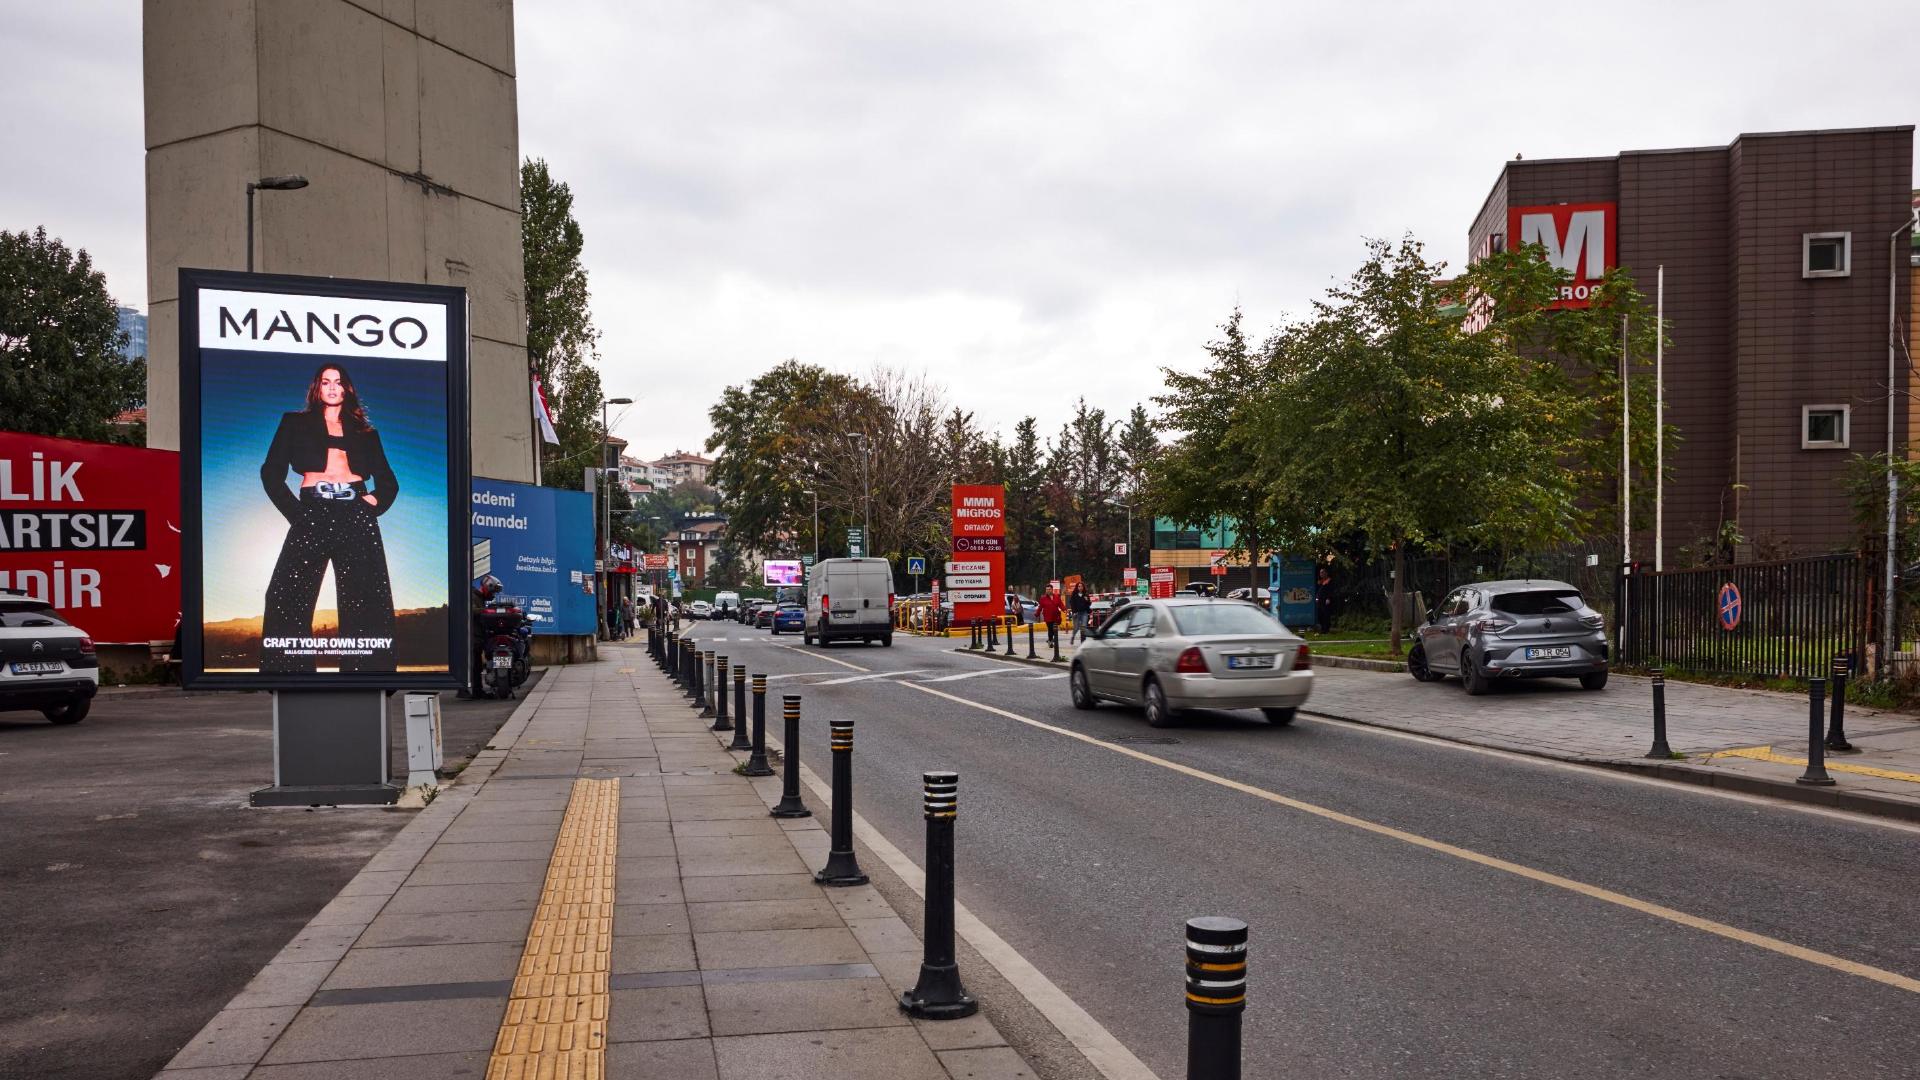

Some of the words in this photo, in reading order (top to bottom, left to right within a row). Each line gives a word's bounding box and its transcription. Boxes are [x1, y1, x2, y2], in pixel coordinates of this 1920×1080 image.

[1521, 210, 1604, 280] M
[220, 306, 428, 349] MANGO
[0, 452, 84, 502] LİK
[964, 498, 994, 507] MMM
[263, 637, 298, 648] CRAFT
[299, 638, 328, 648] YOUR
[330, 638, 355, 648] OWN
[357, 638, 392, 648] STORY
